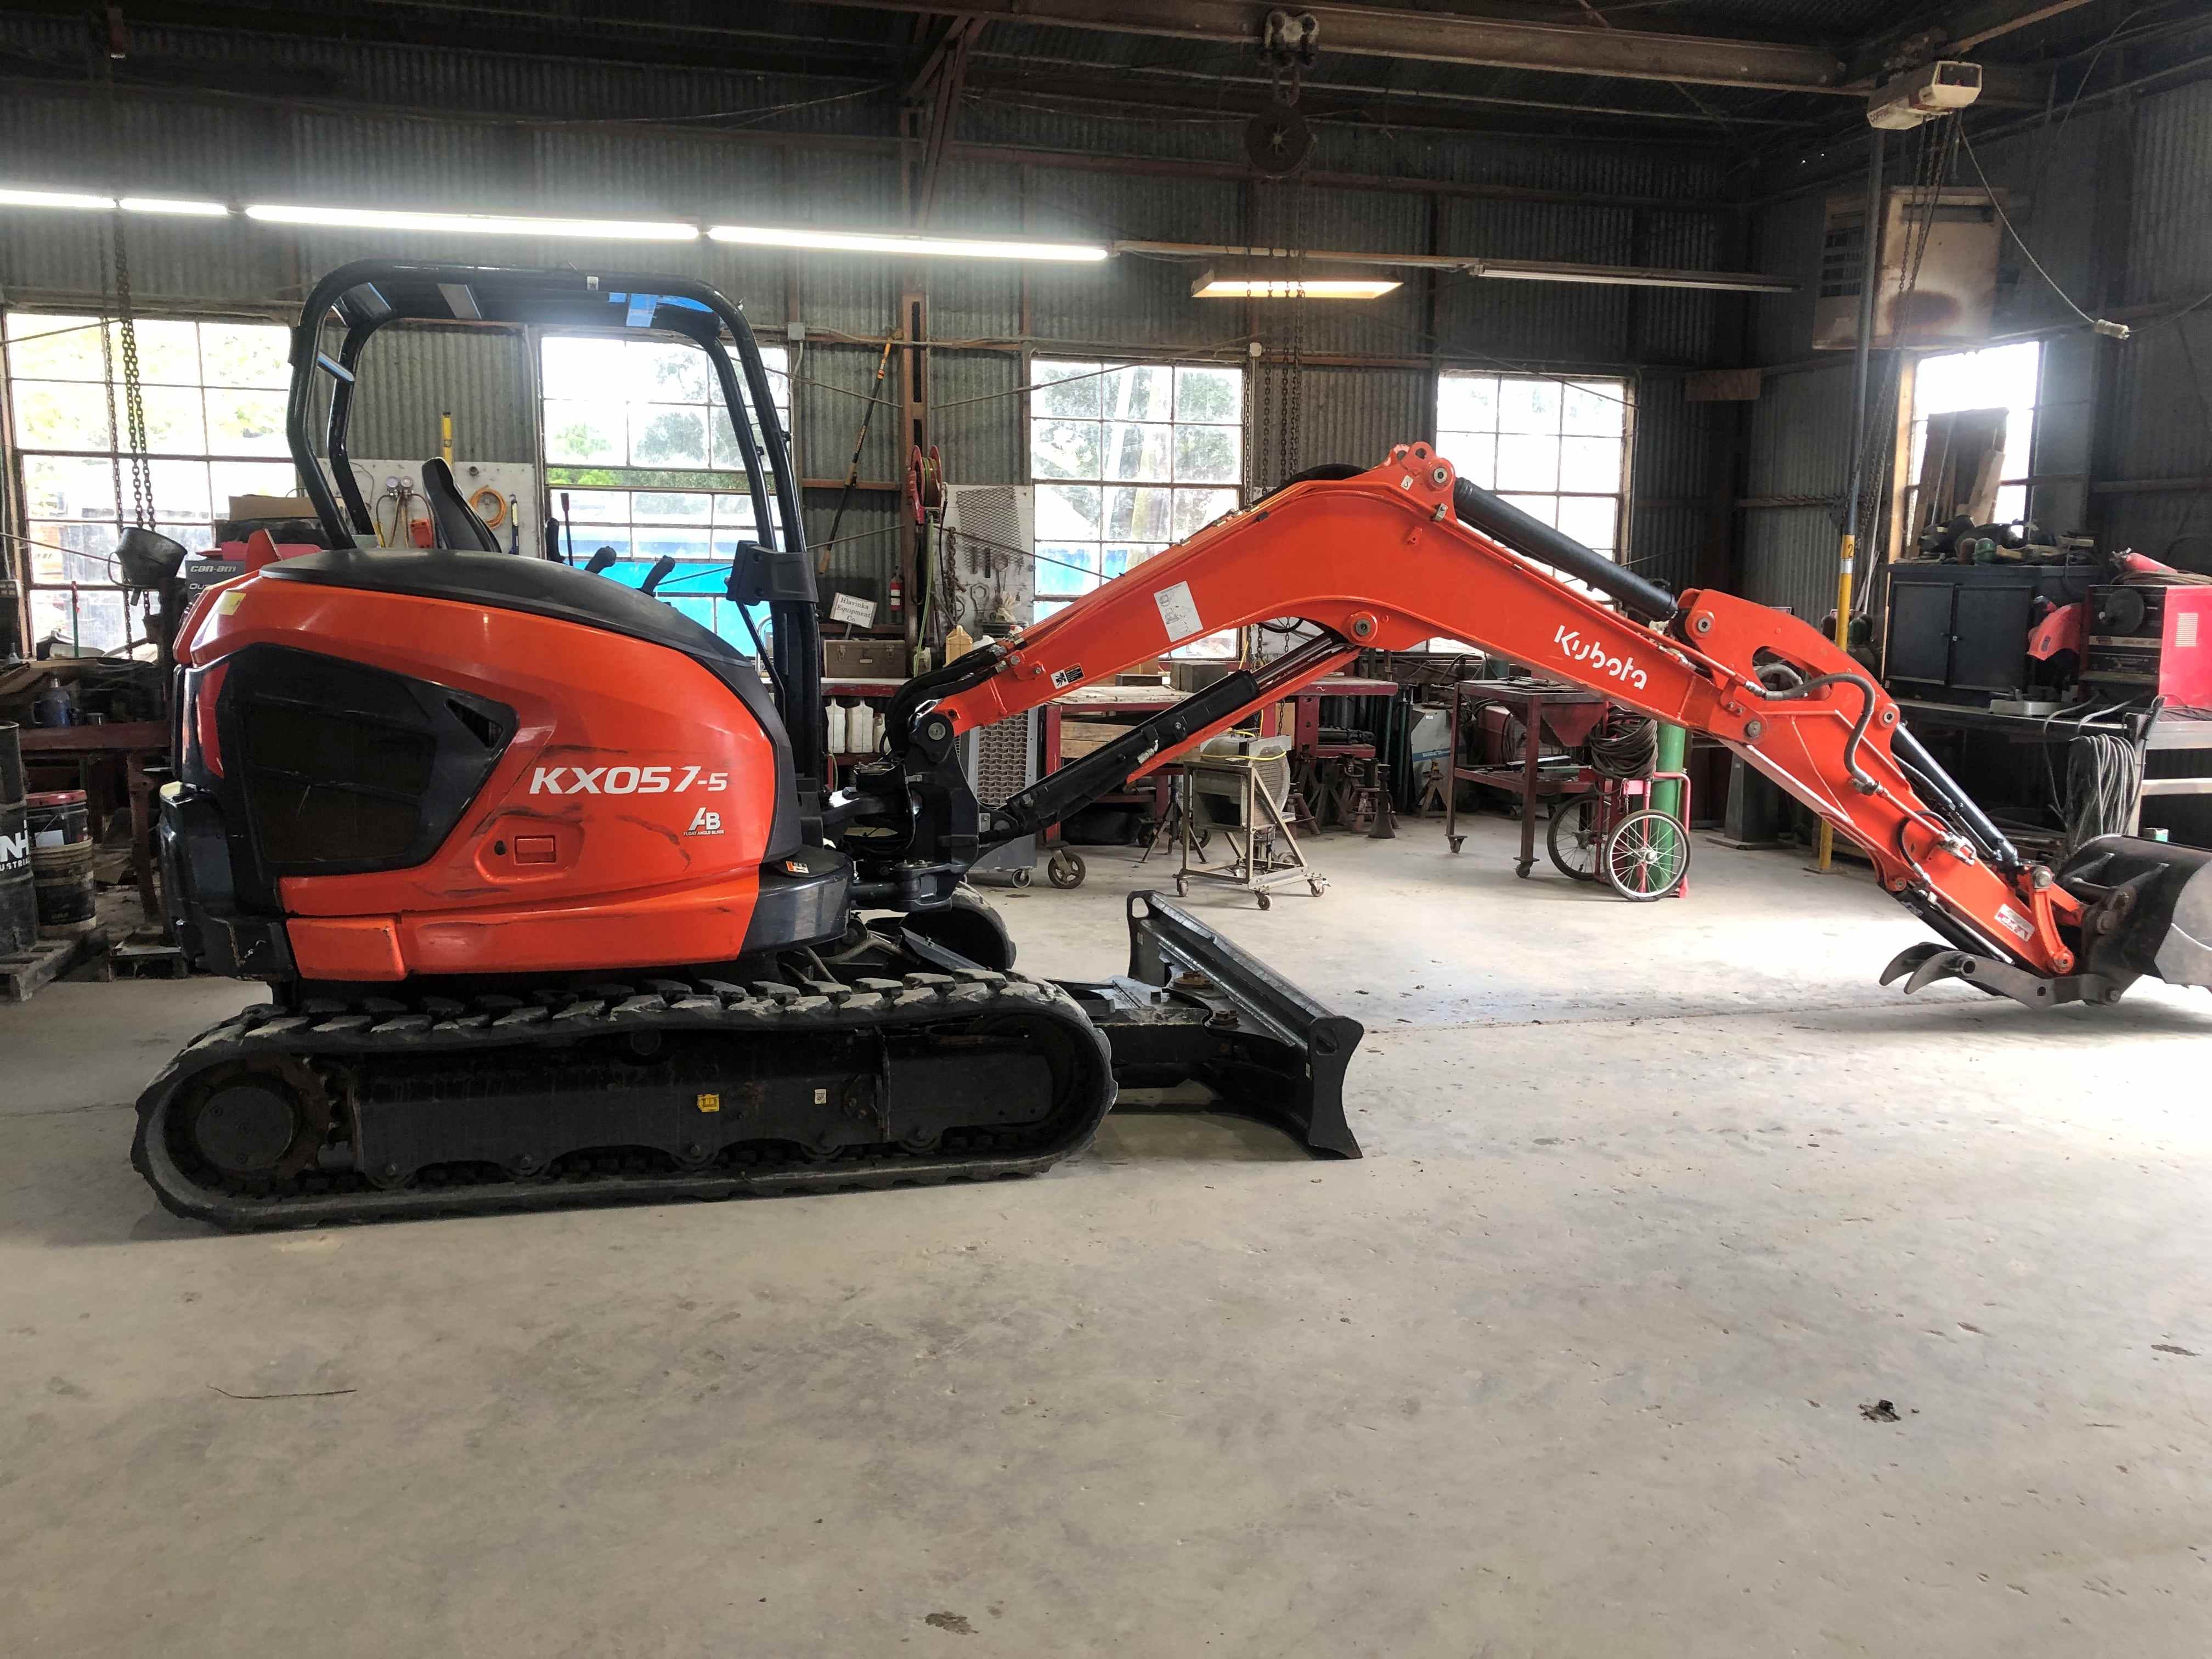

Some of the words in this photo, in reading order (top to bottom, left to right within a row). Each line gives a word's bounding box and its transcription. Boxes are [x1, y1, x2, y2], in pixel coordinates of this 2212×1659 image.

[1848, 544, 1853, 558] 2
[840, 597, 869, 610] Hlavinka
[1554, 624, 1647, 690] Kubota
[529, 766, 729, 794] KX057-5
[688, 807, 721, 831] AB
